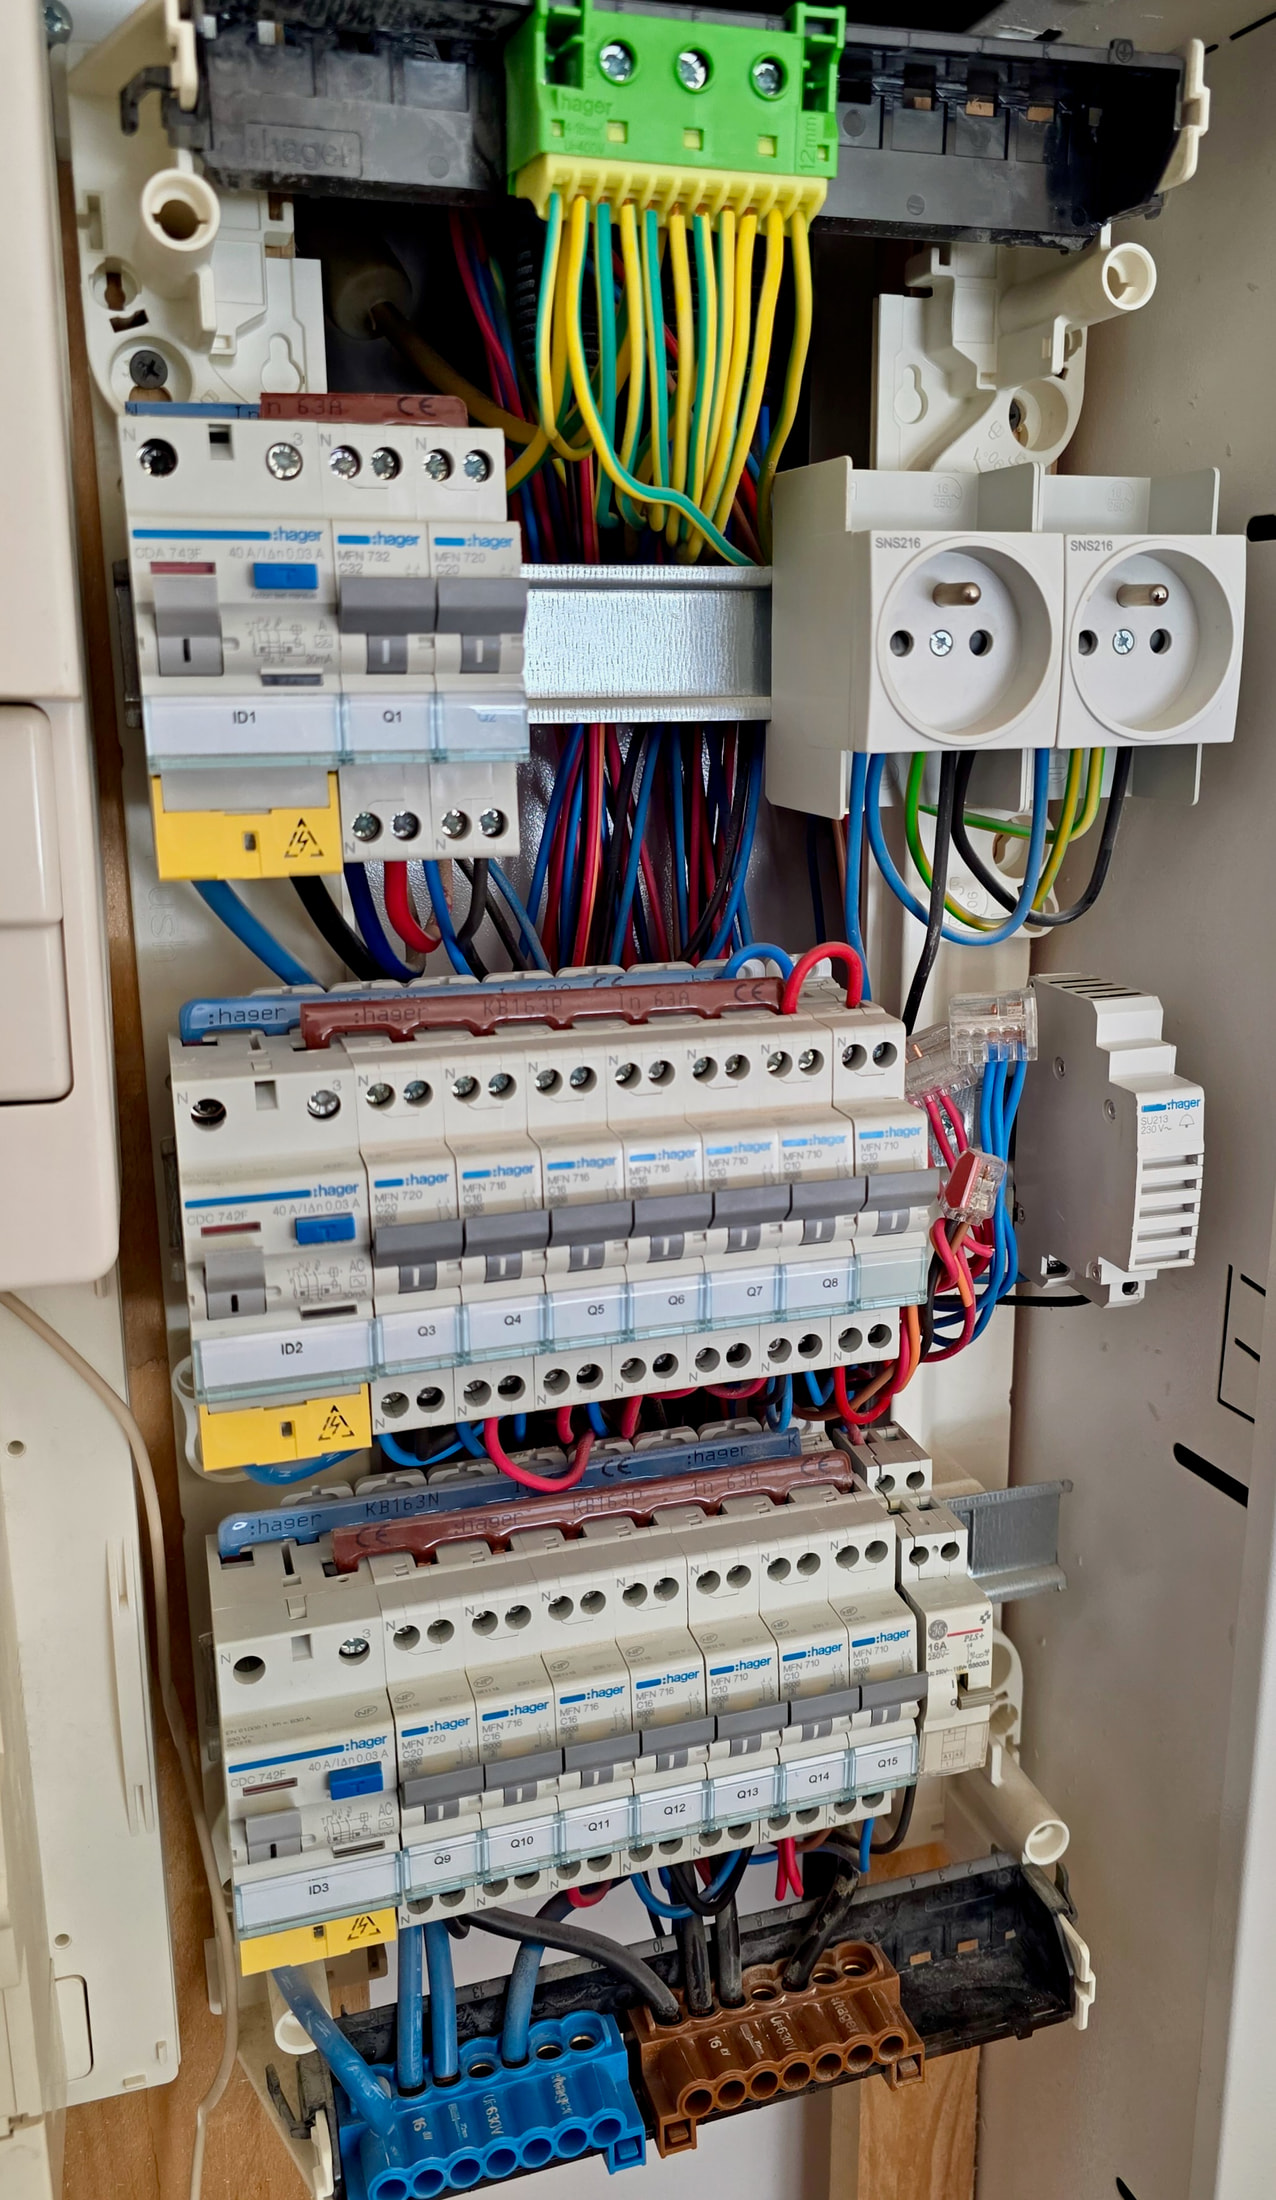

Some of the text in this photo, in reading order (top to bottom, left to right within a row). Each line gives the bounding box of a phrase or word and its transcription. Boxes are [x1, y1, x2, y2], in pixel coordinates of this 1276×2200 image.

[397, 396, 437, 416] CE
[293, 432, 304, 446] 3
[875, 537, 921, 549] SNS216
[1070, 540, 1113, 552] SNS216
[337, 551, 390, 563] MFN 732
[434, 552, 486, 563] MFN 720
[338, 563, 363, 574] C32
[436, 564, 460, 575] C20
[232, 711, 256, 724] ID1
[383, 710, 402, 725] Q1
[734, 983, 766, 1002] CE
[332, 1080, 342, 1090] 3
[1141, 1115, 1169, 1125] SU213
[1141, 1125, 1156, 1135] 230
[273, 1205, 286, 1216] 40
[187, 1214, 214, 1226] CDC
[822, 1277, 839, 1289] Q8
[747, 1285, 763, 1298] Q7
[668, 1294, 685, 1306] Q6
[587, 1304, 605, 1316] Q5
[504, 1314, 522, 1327] Q4
[417, 1325, 436, 1337] Q3
[280, 1342, 303, 1356] ID2
[602, 1456, 632, 1477] CE
[365, 1492, 440, 1517] KB163N
[363, 1628, 371, 1639] 3
[853, 1645, 889, 1659] MFN 710
[928, 1641, 947, 1652] 16A
[783, 1659, 820, 1673] MFN 710
[853, 1657, 869, 1667] C10
[711, 1673, 748, 1687] MFN 710
[784, 1672, 800, 1681] C10
[636, 1687, 674, 1701] MFN 716
[712, 1686, 728, 1695] C10
[560, 1702, 599, 1717] MFN 716
[637, 1700, 654, 1709] C16
[482, 1719, 522, 1734] MFN 716
[560, 1716, 578, 1726] C16
[402, 1734, 446, 1750] MFN 720
[483, 1733, 501, 1742] C16
[402, 1748, 423, 1759] C20
[308, 1761, 321, 1772] 40
[878, 1755, 898, 1768] Q15
[230, 1769, 286, 1788] CDC 742F
[809, 1771, 830, 1784] Q14
[737, 1787, 759, 1800] Q13
[378, 1801, 393, 1817] AC
[664, 1803, 686, 1816] Q12
[588, 1819, 610, 1832] Q11
[510, 1835, 534, 1849] Q10
[434, 1854, 451, 1866] Q9
[308, 1882, 329, 1896] ID3
